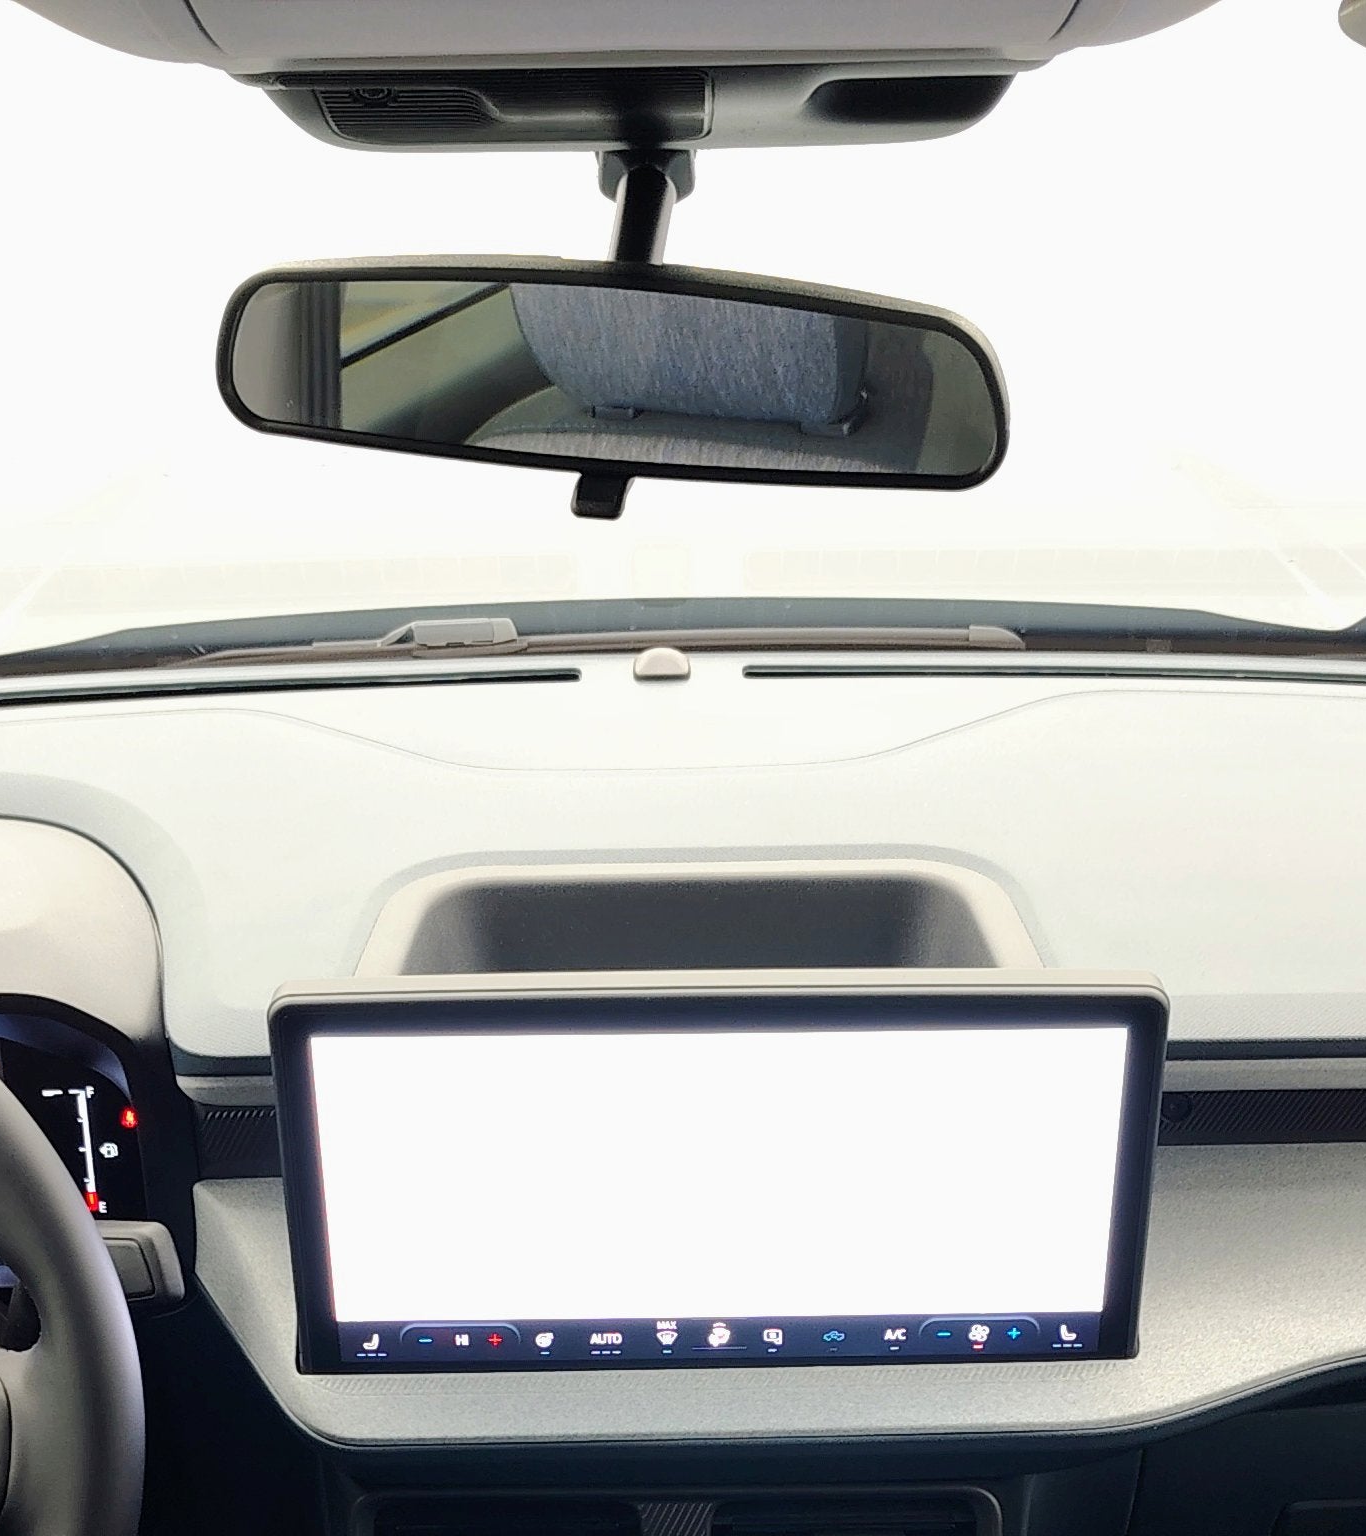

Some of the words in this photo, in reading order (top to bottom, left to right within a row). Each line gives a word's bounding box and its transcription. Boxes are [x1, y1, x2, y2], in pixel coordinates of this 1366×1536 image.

[98, 1201, 108, 1213] E
[656, 1321, 677, 1331] MAX
[590, 1333, 623, 1345] AUTO
[884, 1328, 907, 1341] A/C
